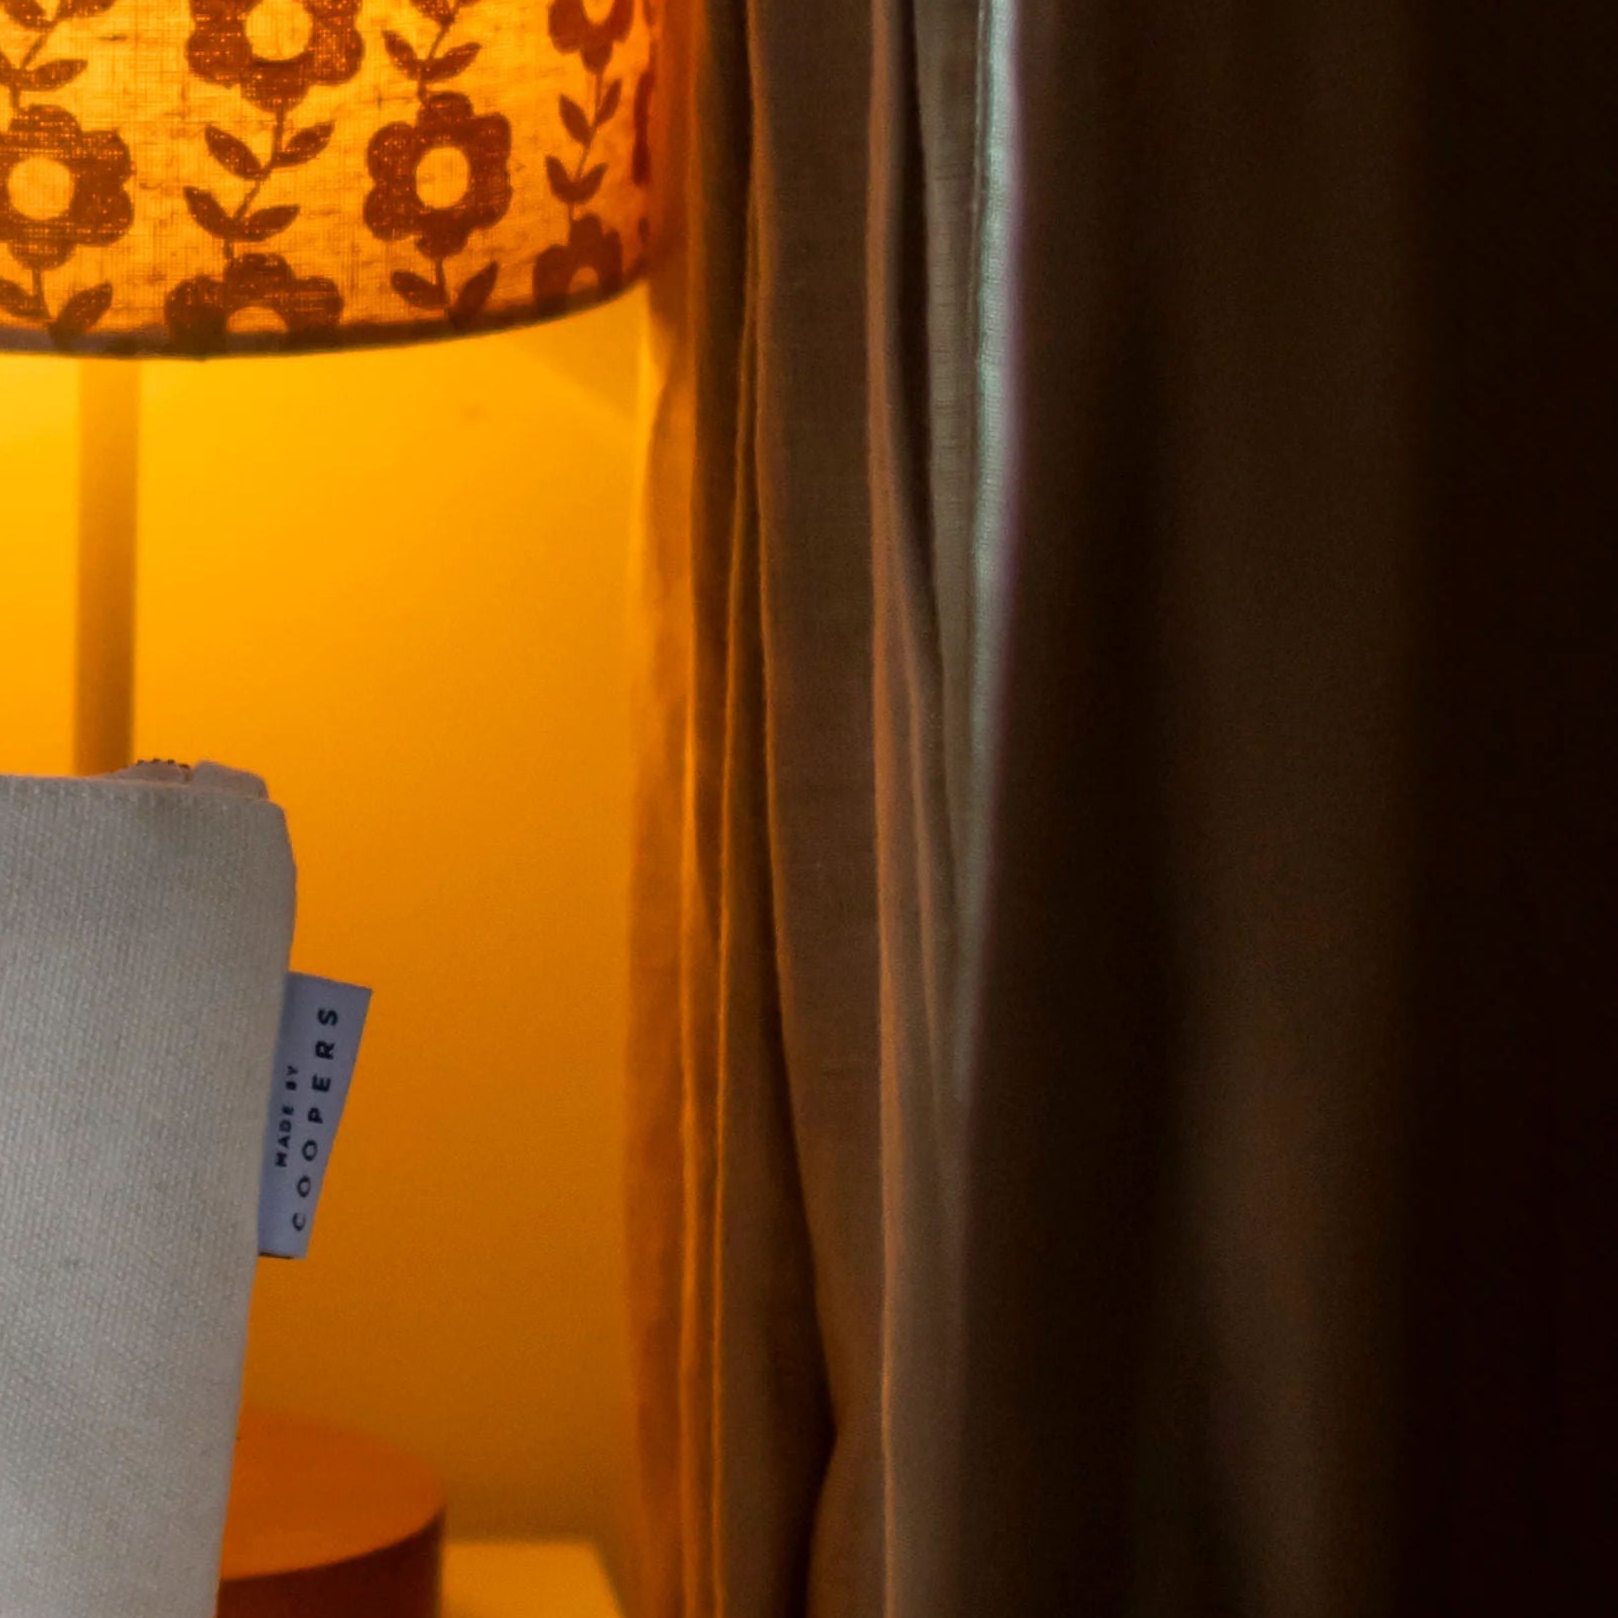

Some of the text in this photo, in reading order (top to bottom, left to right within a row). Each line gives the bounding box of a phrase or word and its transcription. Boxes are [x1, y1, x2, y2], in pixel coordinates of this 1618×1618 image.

[274, 1065, 299, 1168] MADE BY
[292, 1007, 340, 1232] COOPERS
